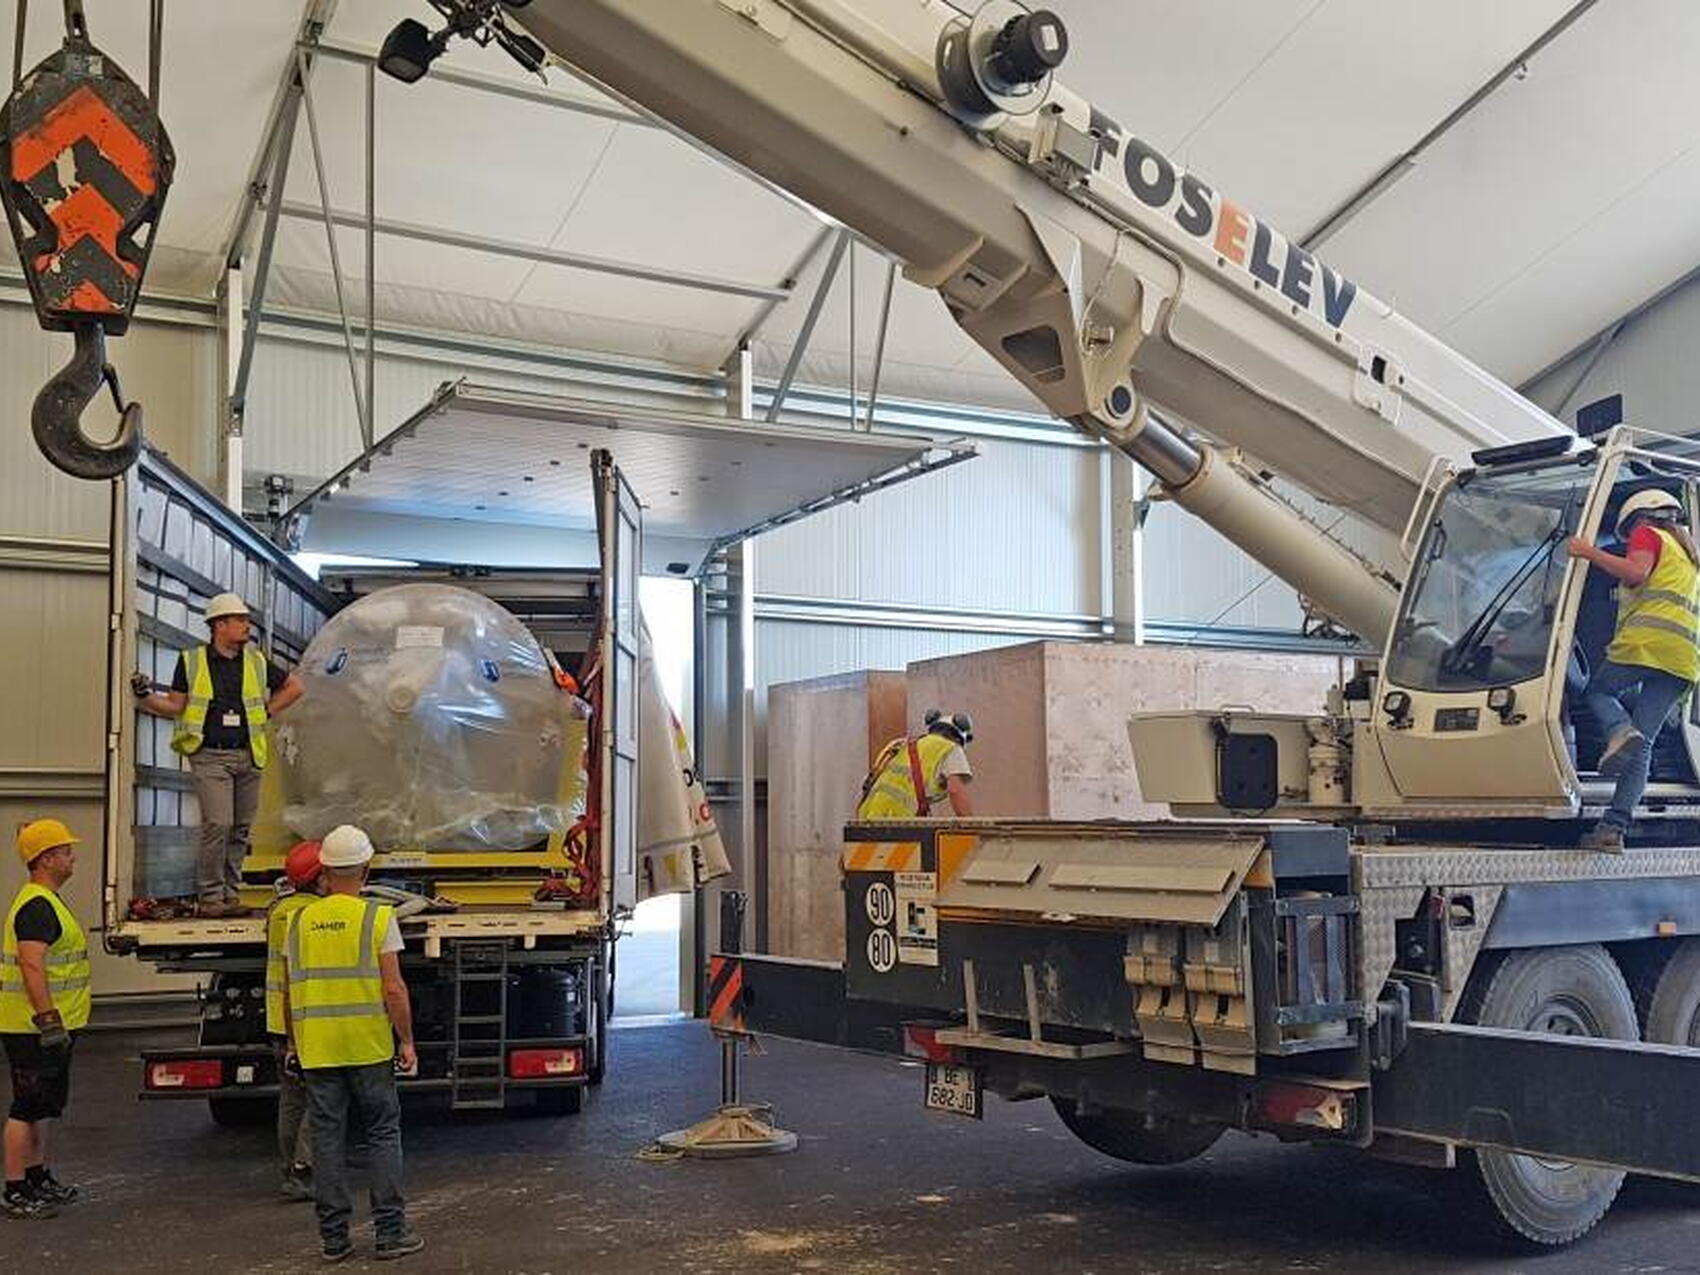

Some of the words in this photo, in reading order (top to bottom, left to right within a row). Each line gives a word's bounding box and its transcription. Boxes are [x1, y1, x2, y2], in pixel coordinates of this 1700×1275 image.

[1089, 103, 1357, 329] FOSELEV
[870, 887, 889, 920] 90
[872, 933, 891, 967] 80
